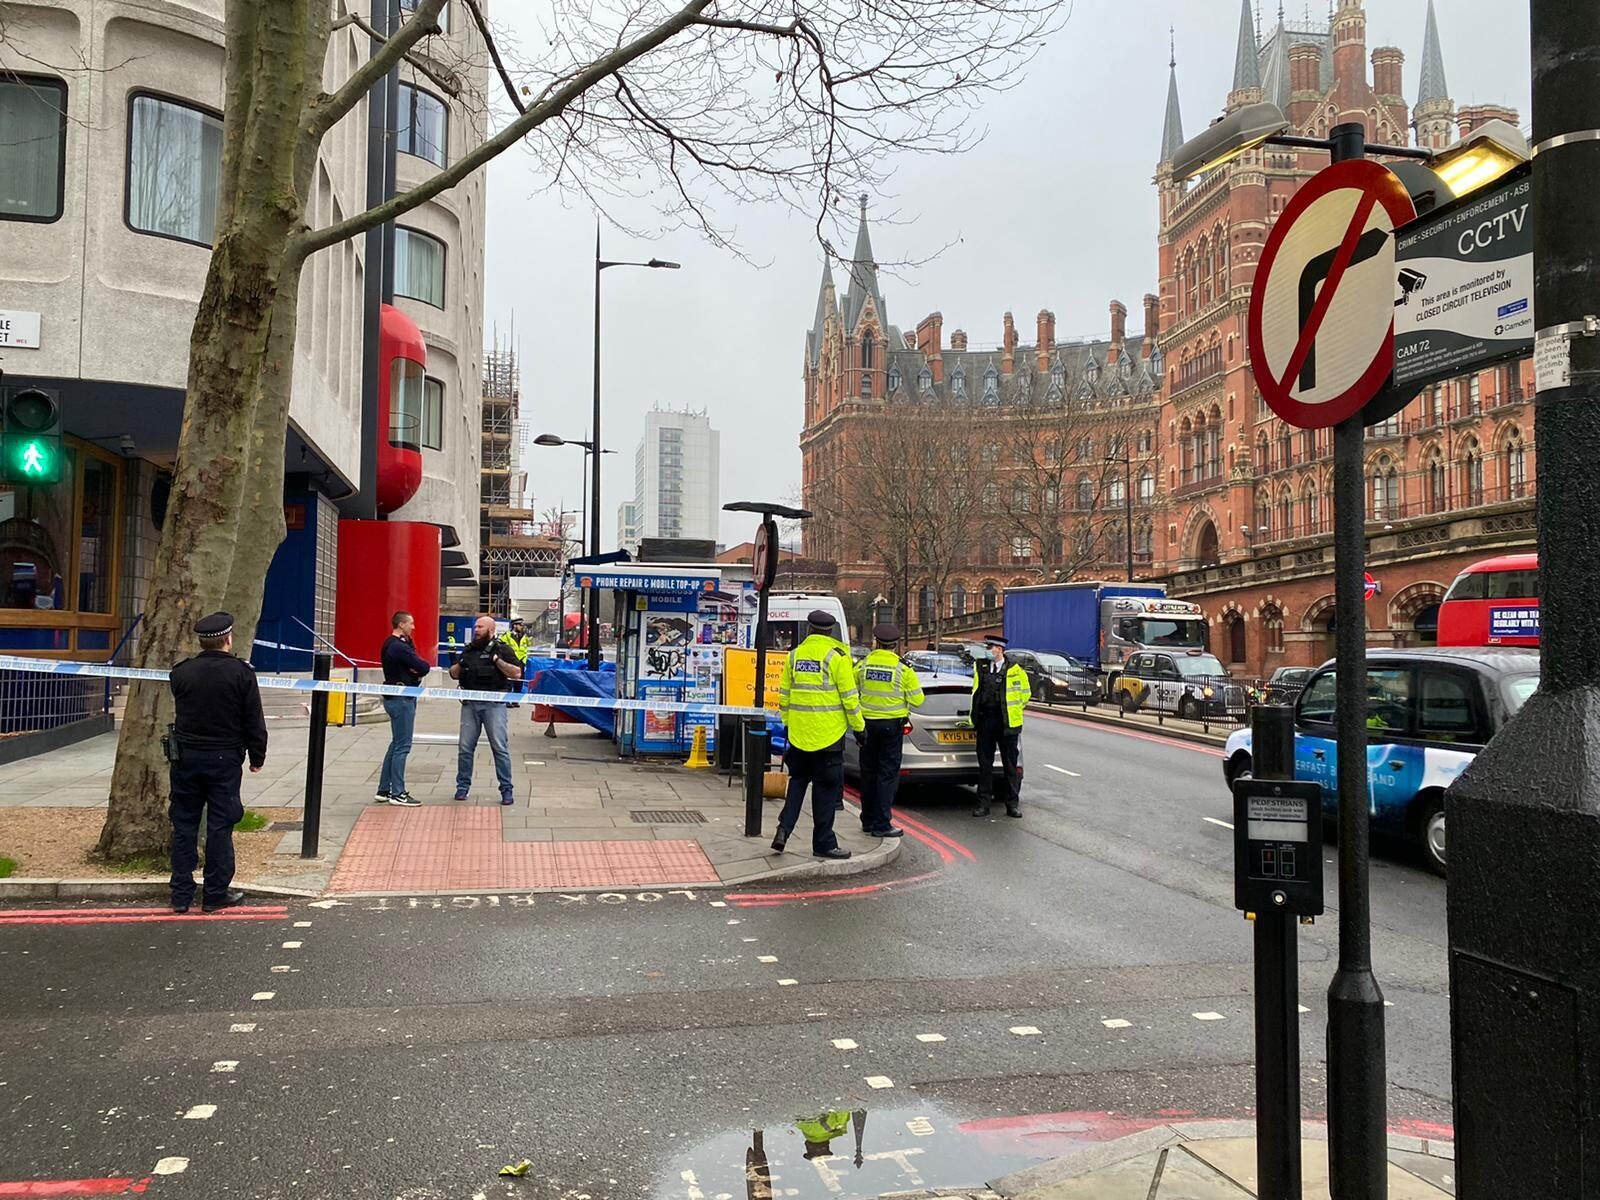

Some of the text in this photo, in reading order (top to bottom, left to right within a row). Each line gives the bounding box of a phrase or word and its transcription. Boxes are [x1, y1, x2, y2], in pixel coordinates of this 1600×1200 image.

[1398, 182, 1530, 251] CRIME SECURITY ENFORCEMENT ASB
[1458, 203, 1529, 255] CCTV
[1422, 269, 1506, 308] This area is monitored by
[1416, 279, 1512, 322] CLOSED CIRCUIT TELEVISION
[1504, 318, 1532, 331] Camden
[1396, 344, 1418, 358] CAM
[1420, 340, 1430, 352] 72
[596, 576, 618, 587] PHONE
[620, 578, 642, 588] REPAIR
[650, 579, 674, 590] MOBILE
[676, 580, 700, 590] TOP-UP
[651, 596, 682, 604] MOBILE
[867, 672, 891, 681] POLICE
[944, 732, 961, 740] KY15
[1295, 759, 1327, 774] ERFAST
[1251, 799, 1304, 807] PEDESTRIANS
[362, 890, 697, 911] LOOK RIGHT
